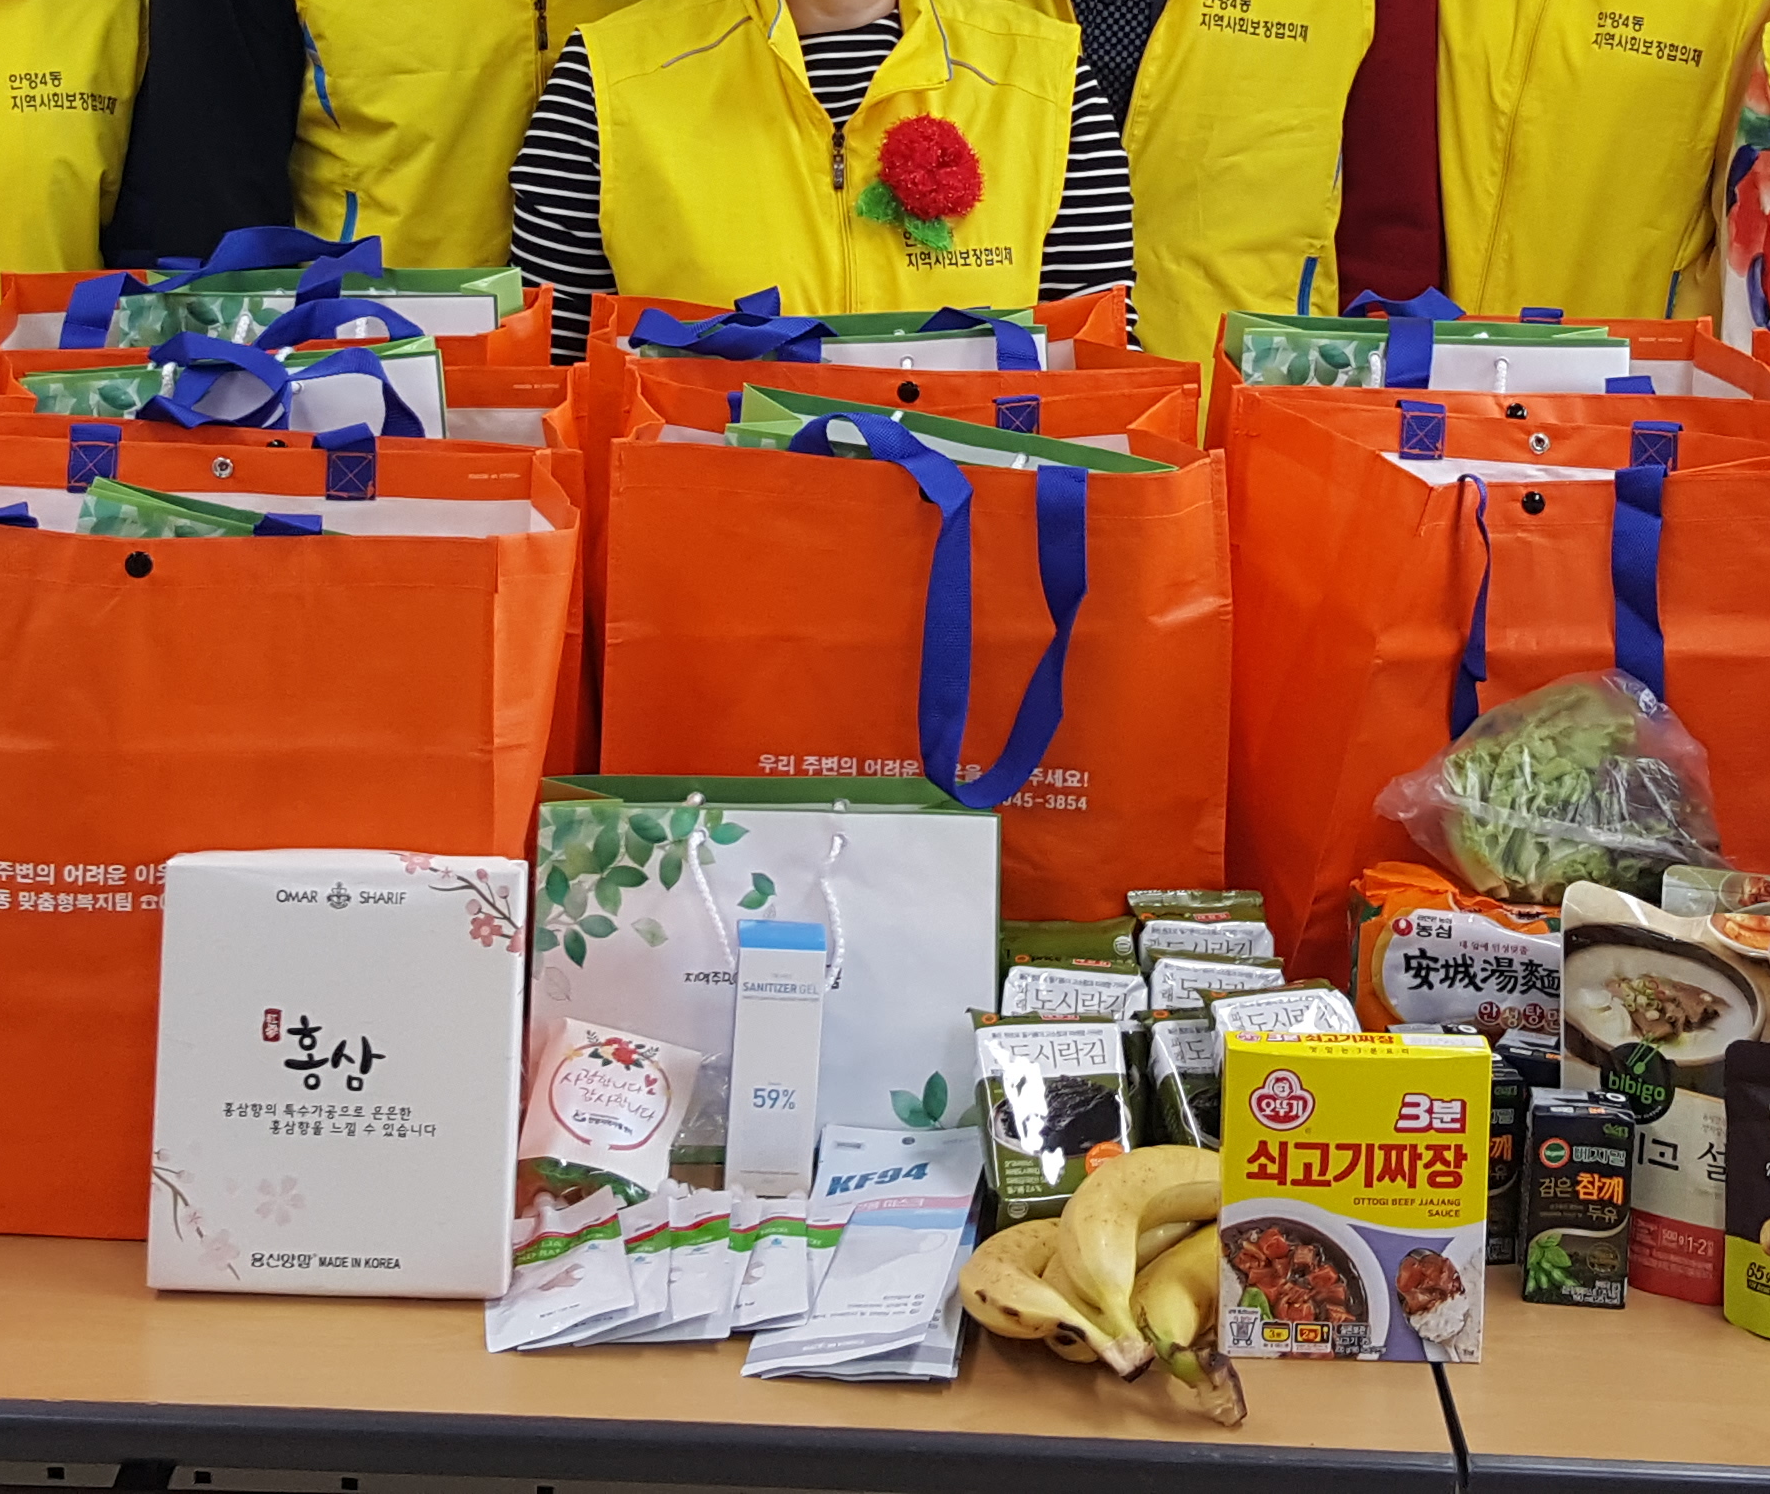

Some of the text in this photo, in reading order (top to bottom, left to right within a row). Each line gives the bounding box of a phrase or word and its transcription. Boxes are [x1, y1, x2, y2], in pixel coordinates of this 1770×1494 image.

[1199, 12, 1309, 43] 지역사회보장협의체
[1597, 11, 1644, 33] 안양4동
[1591, 32, 1703, 68] 지역사회보장협의체
[8, 71, 63, 91] 안양4동
[906, 246, 1013, 271] 지역사회보장협의체
[758, 754, 1089, 789] 우리 주변의 어려운 주세요!
[63, 863, 127, 886] 어려운
[18, 890, 133, 913] 맞춤형복지팀
[276, 889, 407, 905] OMAR SHARIF
[1416, 922, 1453, 939] 농심
[743, 982, 819, 995] SANITIZER GEL
[1032, 989, 1127, 1021] 도시락김
[284, 1014, 387, 1092] 홍삼
[560, 1068, 643, 1094] 사랑합니다
[1609, 1070, 1666, 1104] bibigo
[579, 1087, 657, 1121] 감사합니다
[753, 1088, 796, 1110] 59%
[1261, 1099, 1306, 1117] 오뚜기
[223, 1102, 412, 1122] 홍삼향의 특수가공으로 은은한
[1395, 1093, 1463, 1130] 3분
[269, 1120, 437, 1137] 홍삼향을 느낄 수 있습니다
[1245, 1139, 1469, 1189] 쇠고기짜장
[1572, 1146, 1627, 1167] 베지밀
[826, 1162, 931, 1197] KF94
[1539, 1172, 1625, 1205] 검은 참깨
[1353, 1197, 1389, 1206] OTTOGI
[1391, 1197, 1416, 1206] BEEF
[1427, 1208, 1461, 1218] SAUCE
[1587, 1205, 1619, 1224] 두유
[319, 1257, 349, 1268] MADE
[351, 1257, 361, 1268] IN
[364, 1257, 401, 1269] KOREA
